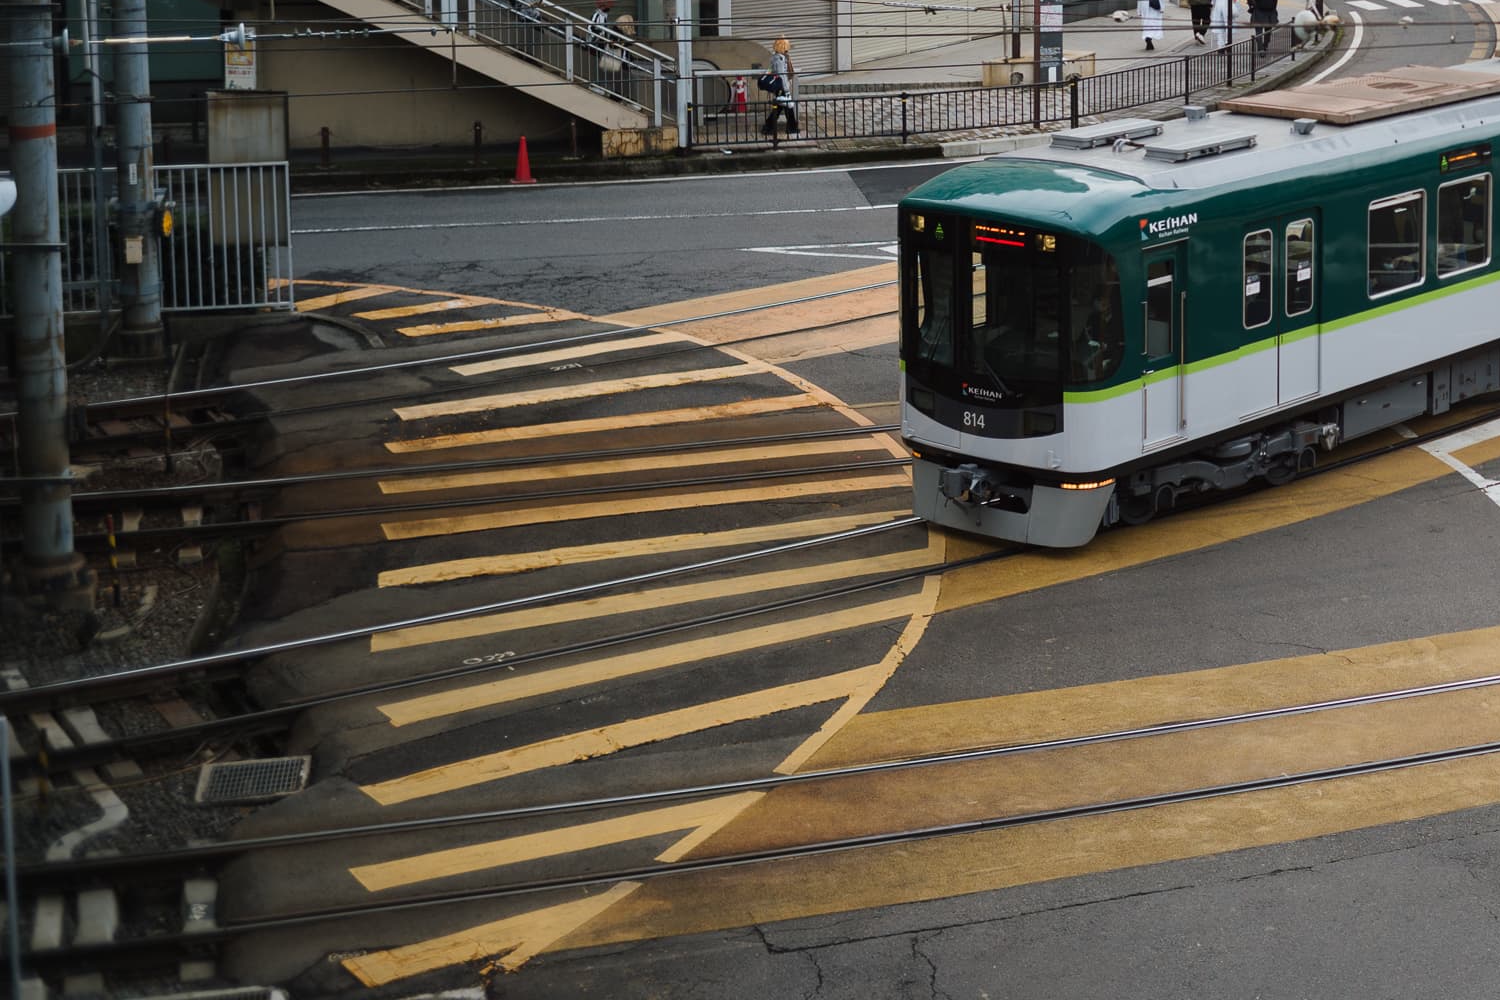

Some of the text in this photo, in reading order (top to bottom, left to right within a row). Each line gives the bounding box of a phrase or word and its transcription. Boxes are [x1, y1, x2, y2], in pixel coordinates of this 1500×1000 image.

[1149, 212, 1198, 234] KEIHAN
[968, 386, 1003, 399] KEIHAN
[963, 411, 986, 429] 814
